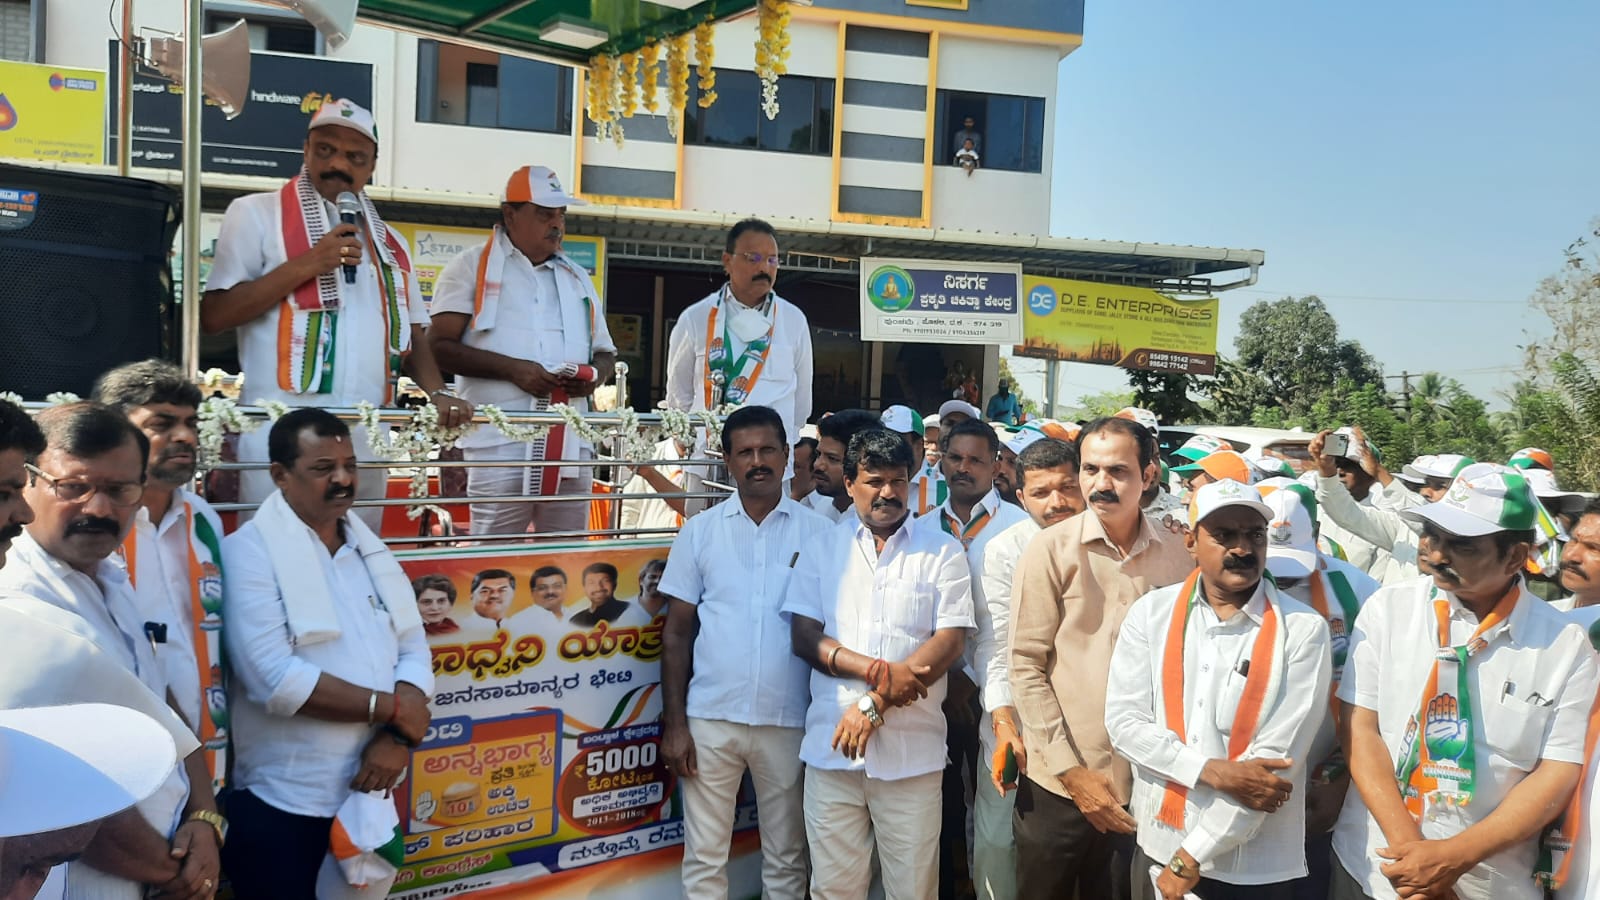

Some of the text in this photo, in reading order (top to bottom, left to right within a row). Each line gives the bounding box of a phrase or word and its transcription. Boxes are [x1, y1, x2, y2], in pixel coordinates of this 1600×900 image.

[251, 90, 301, 104] hindware
[943, 273, 989, 290] ನಿಸರ್ಗ
[984, 296, 1013, 311] ಕೇಂದ್ರ
[1061, 293, 1212, 320] D.E. ENTERPRISES
[435, 669, 633, 706] ಜನಸಾಮಾನ್ಯರ ಭೇಟಿ
[423, 735, 553, 776] ಅನ್ನಭಾಗ್ಯ
[586, 742, 657, 776] 5000
[444, 817, 535, 848] ಪರಿಹಾರ
